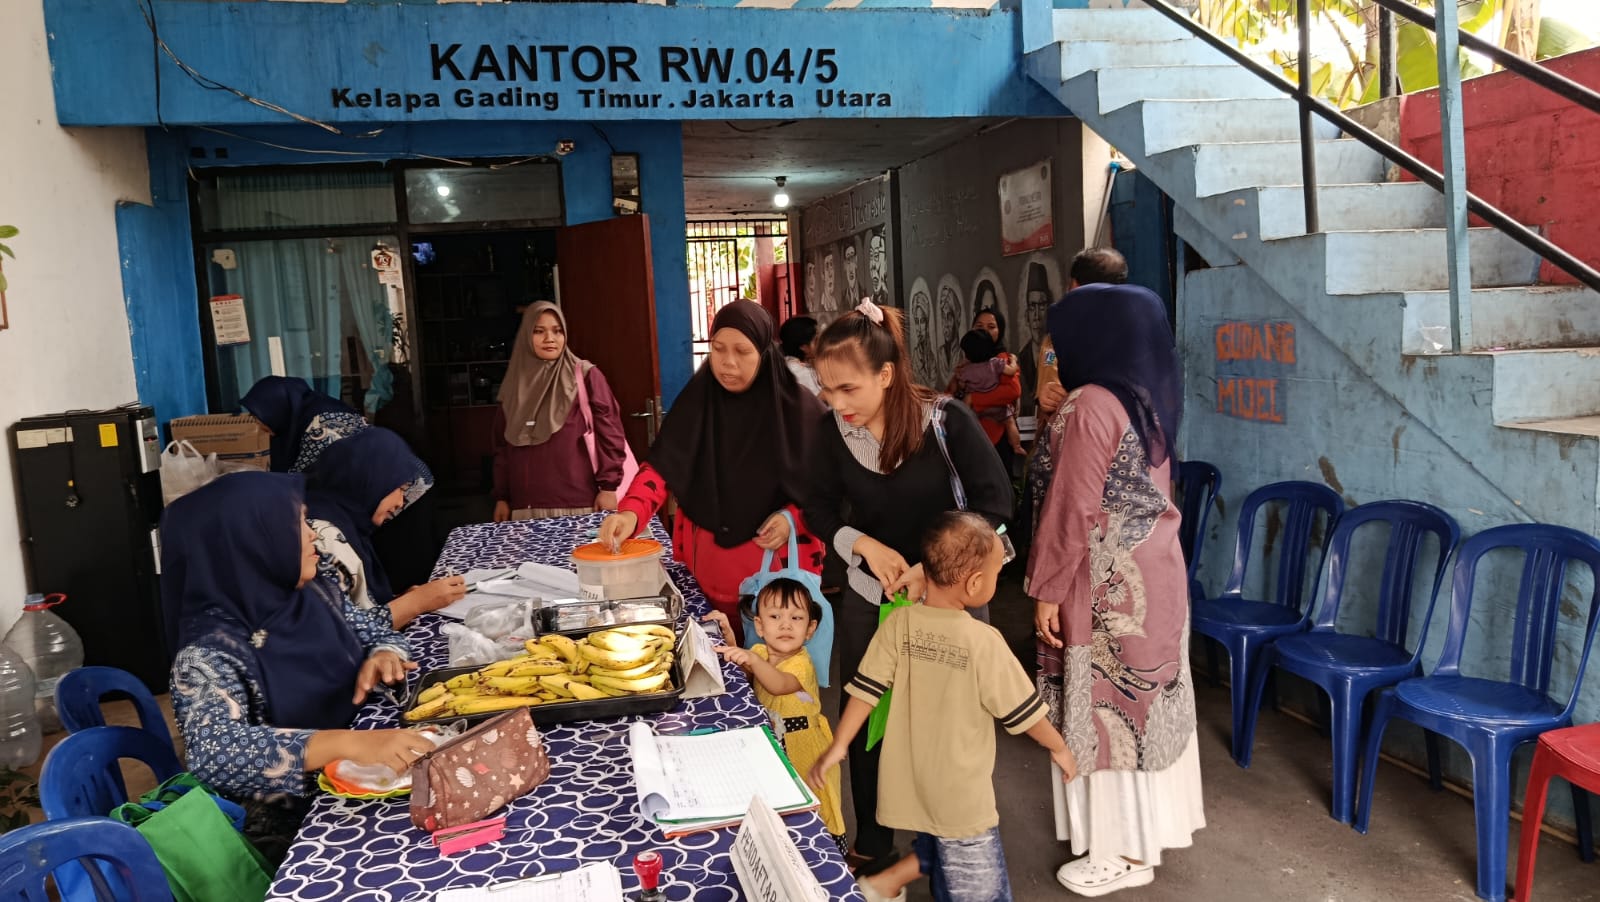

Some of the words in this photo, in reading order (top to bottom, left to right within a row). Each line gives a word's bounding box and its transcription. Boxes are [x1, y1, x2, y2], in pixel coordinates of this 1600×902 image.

[430, 43, 641, 83] KANTOR
[660, 46, 838, 85] RW.04/5
[331, 87, 441, 114] Kelapa
[454, 86, 559, 112] Gading
[681, 89, 794, 109] Jakarta
[816, 89, 892, 108] Utara
